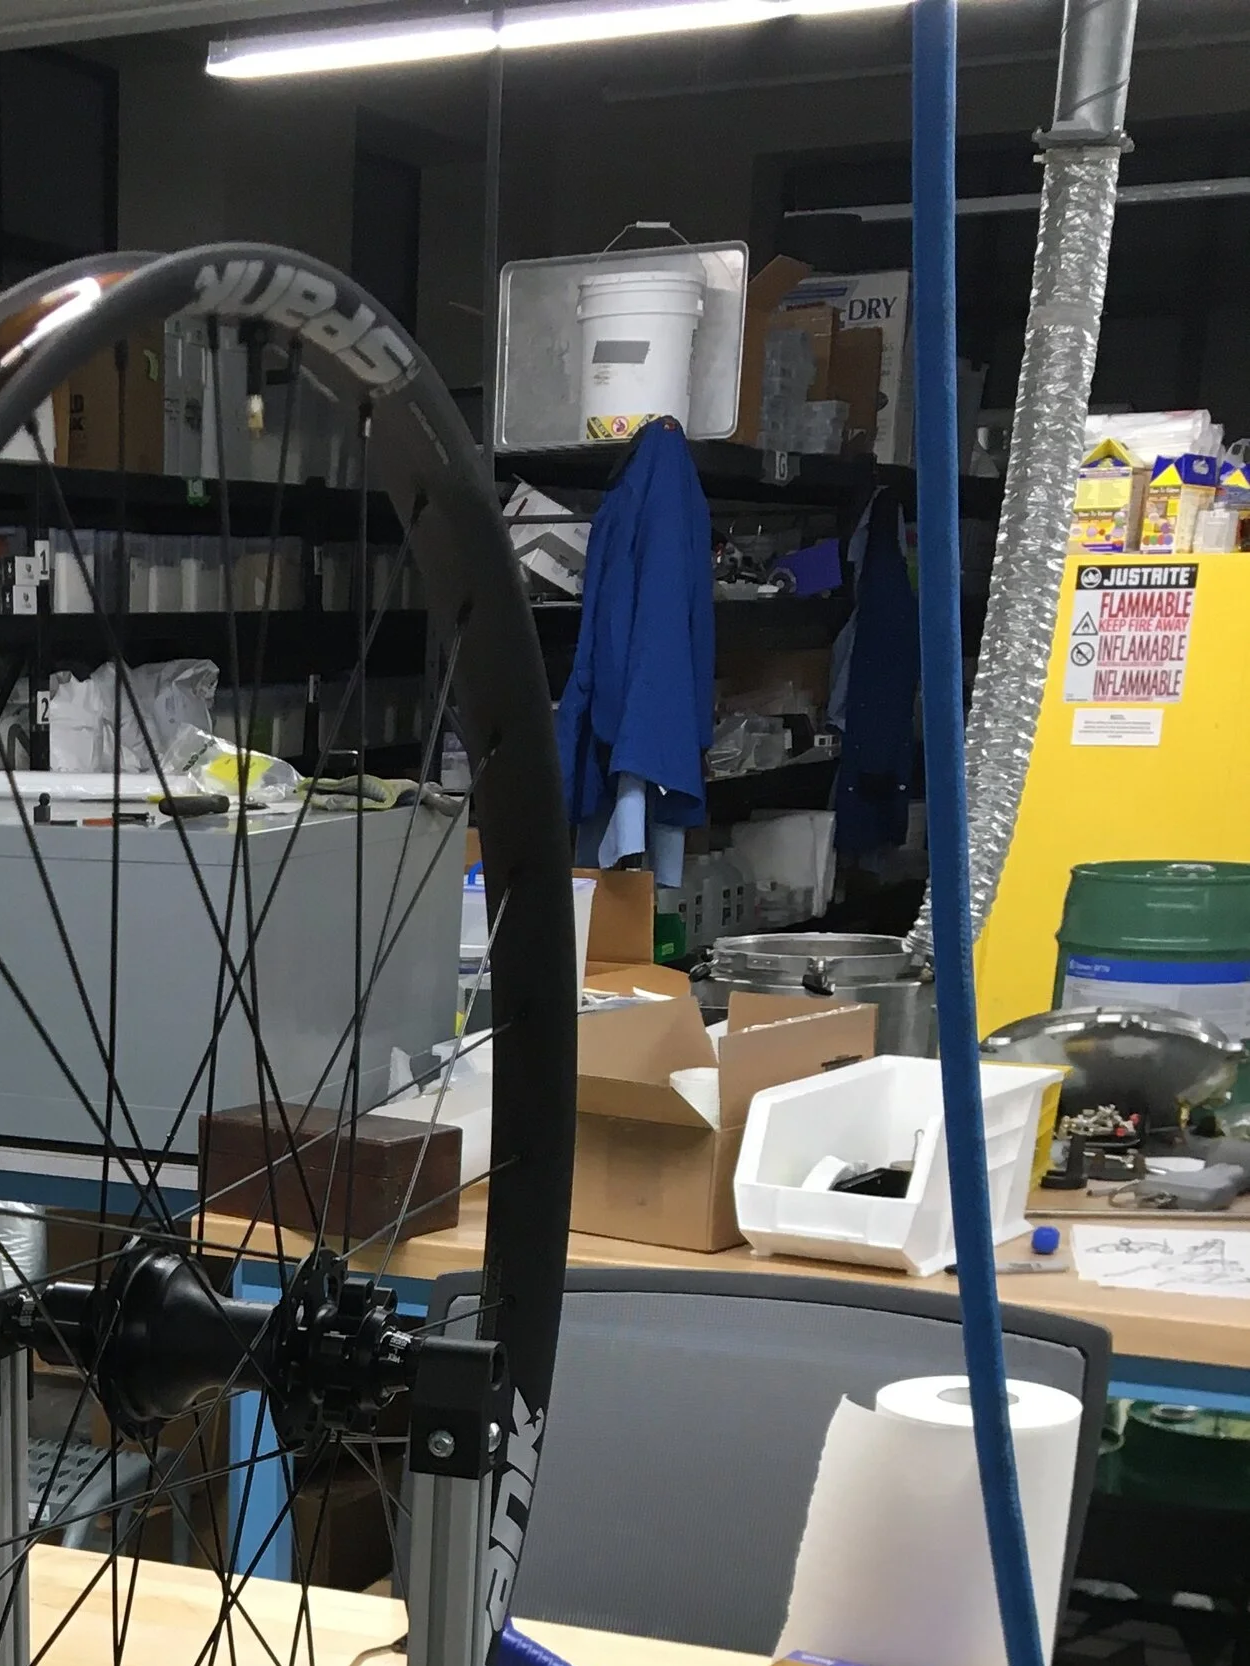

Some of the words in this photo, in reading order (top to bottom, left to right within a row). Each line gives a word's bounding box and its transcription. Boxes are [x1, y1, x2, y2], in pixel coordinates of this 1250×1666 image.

[1103, 566, 1191, 586] JUSTRITE
[1100, 591, 1193, 619] FLAMMABLE
[1098, 619, 1127, 633] KEEP
[1128, 618, 1152, 632] FIRE
[1155, 618, 1189, 632] AWAY
[1097, 634, 1187, 662] INFLAMABLE
[1093, 669, 1182, 697] INFLAMMABLE
